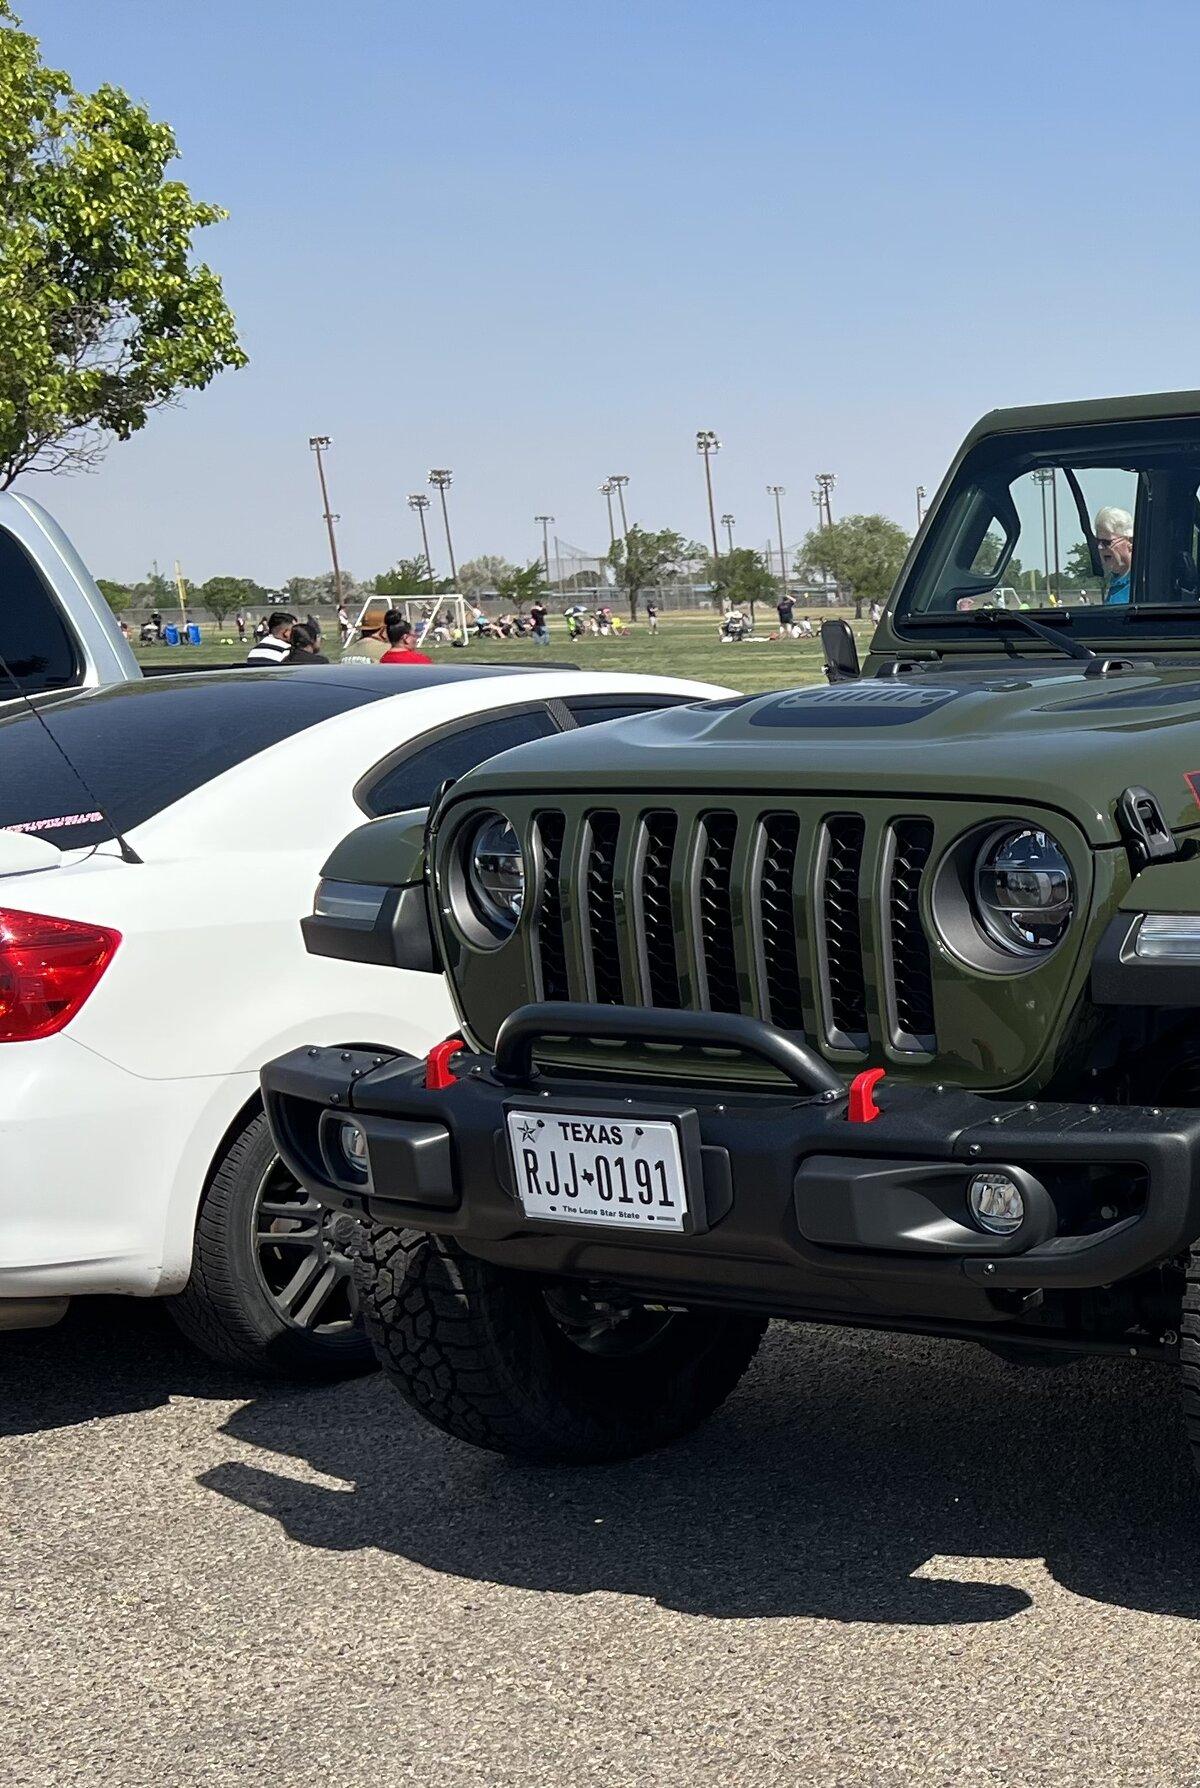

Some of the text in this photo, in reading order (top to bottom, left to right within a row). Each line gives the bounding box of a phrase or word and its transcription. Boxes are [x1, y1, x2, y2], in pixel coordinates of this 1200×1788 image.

[558, 1121, 623, 1146] TEXAS
[562, 1205, 640, 1220] The Lone Star State
